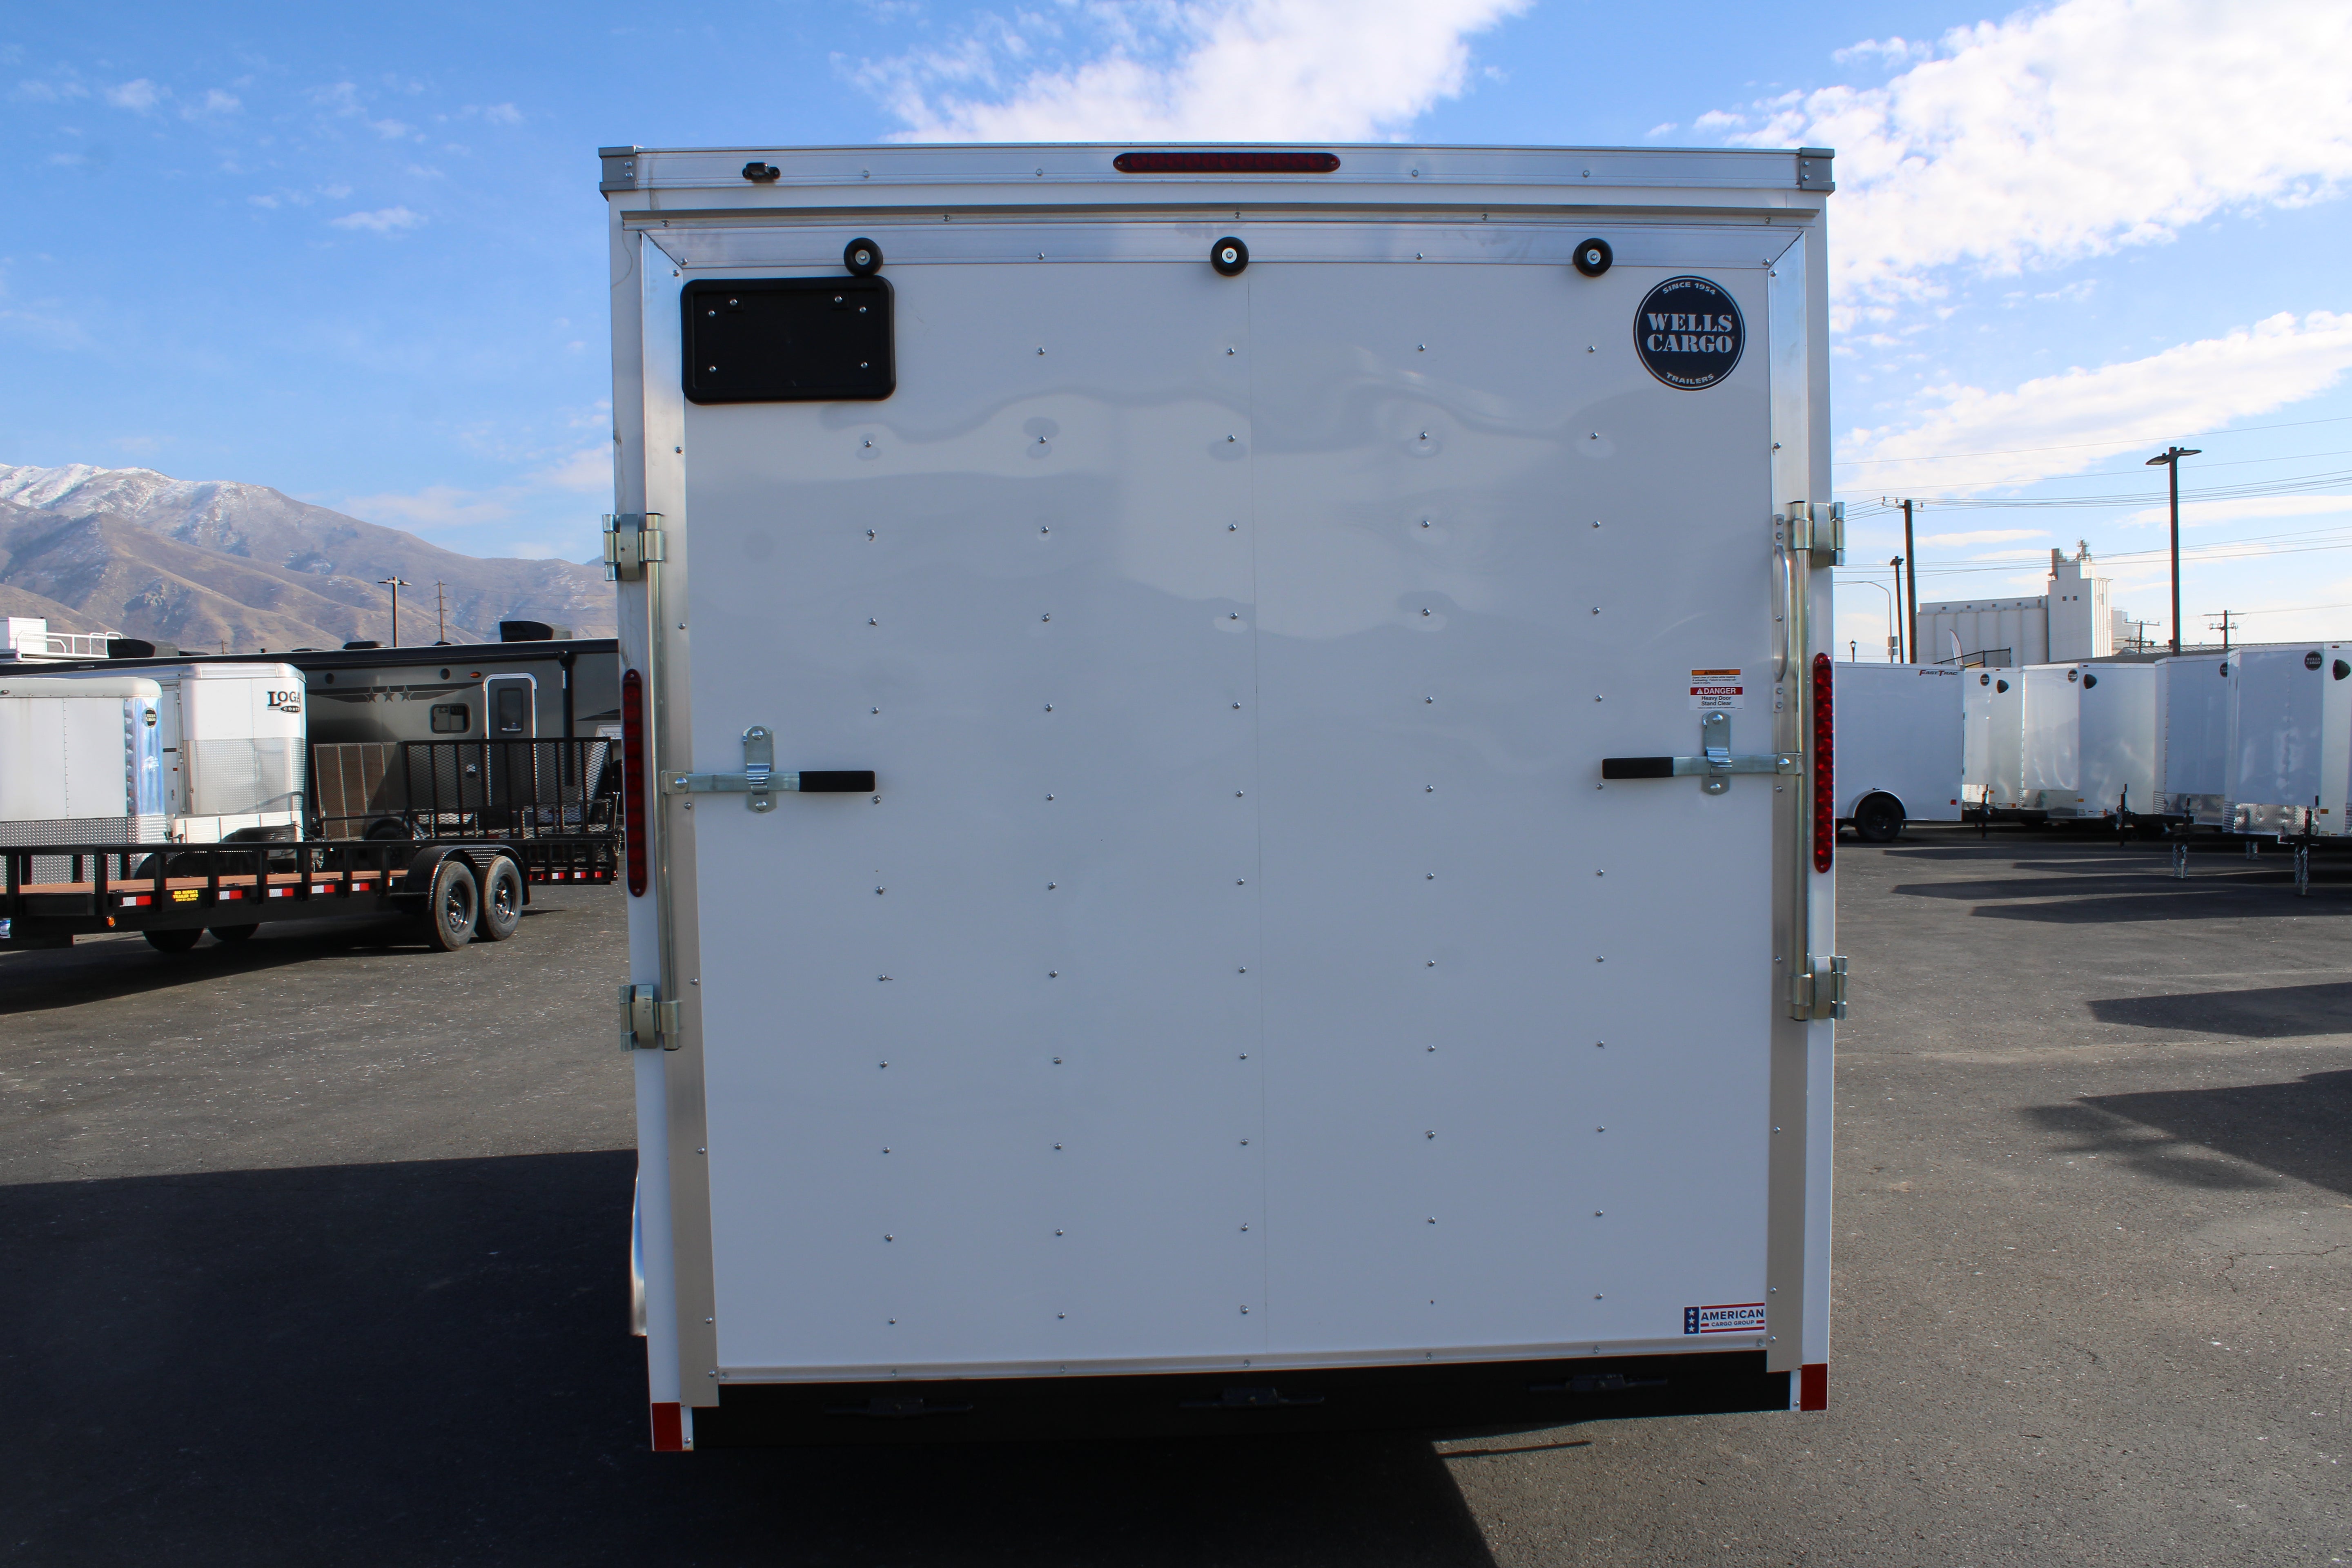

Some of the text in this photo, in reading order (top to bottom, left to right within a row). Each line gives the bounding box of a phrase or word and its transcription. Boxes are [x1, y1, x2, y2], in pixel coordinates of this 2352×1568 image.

[1662, 282, 1716, 295] SINCE 1954
[1647, 313, 1732, 332] WELLS
[1647, 334, 1733, 353] CARGO
[1666, 372, 1715, 384] TRAILERS
[267, 691, 300, 706] LOGA
[1700, 1309, 1764, 1321] AMERICAN
